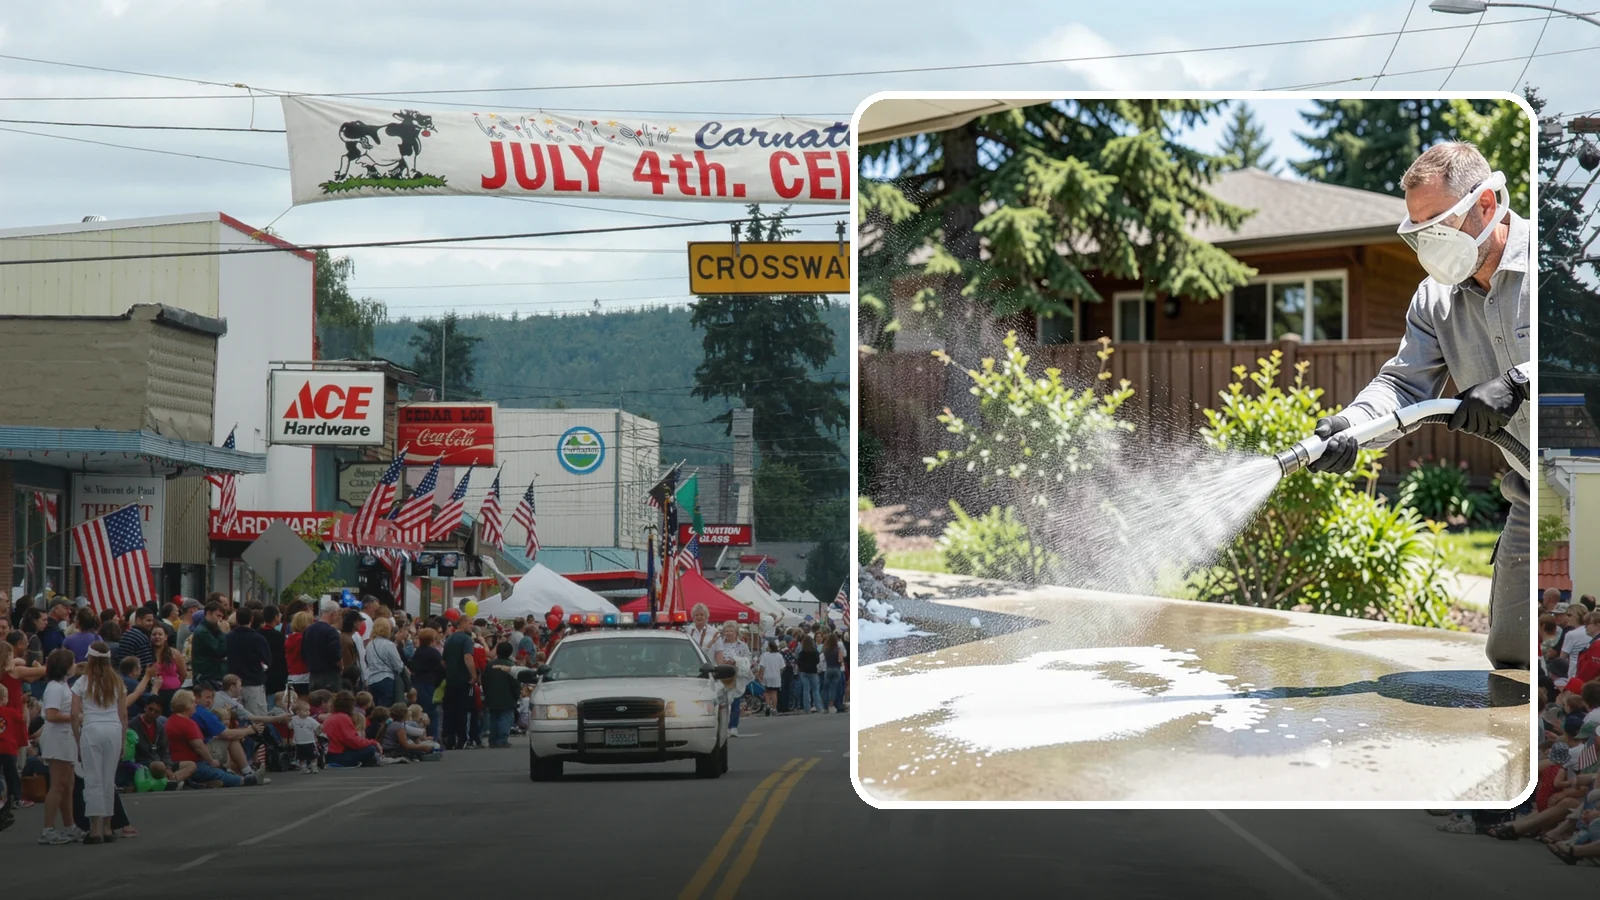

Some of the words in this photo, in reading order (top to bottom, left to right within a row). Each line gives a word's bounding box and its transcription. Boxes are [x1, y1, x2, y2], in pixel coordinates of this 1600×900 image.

[481, 141, 605, 192] JULY
[632, 150, 746, 198] 4th.
[697, 254, 850, 280] CROSSWA
[282, 380, 373, 420] ACE
[405, 409, 452, 422] CEDAR
[461, 409, 485, 422] LOG
[283, 421, 371, 436] Hardware
[416, 427, 477, 447] Coca-Cola
[95, 485, 124, 494] Vincent
[126, 485, 136, 494] de
[137, 486, 155, 495] Paul
[81, 502, 154, 522] THRT
[688, 526, 741, 535] CRNATION
[699, 535, 730, 543] GLASS
